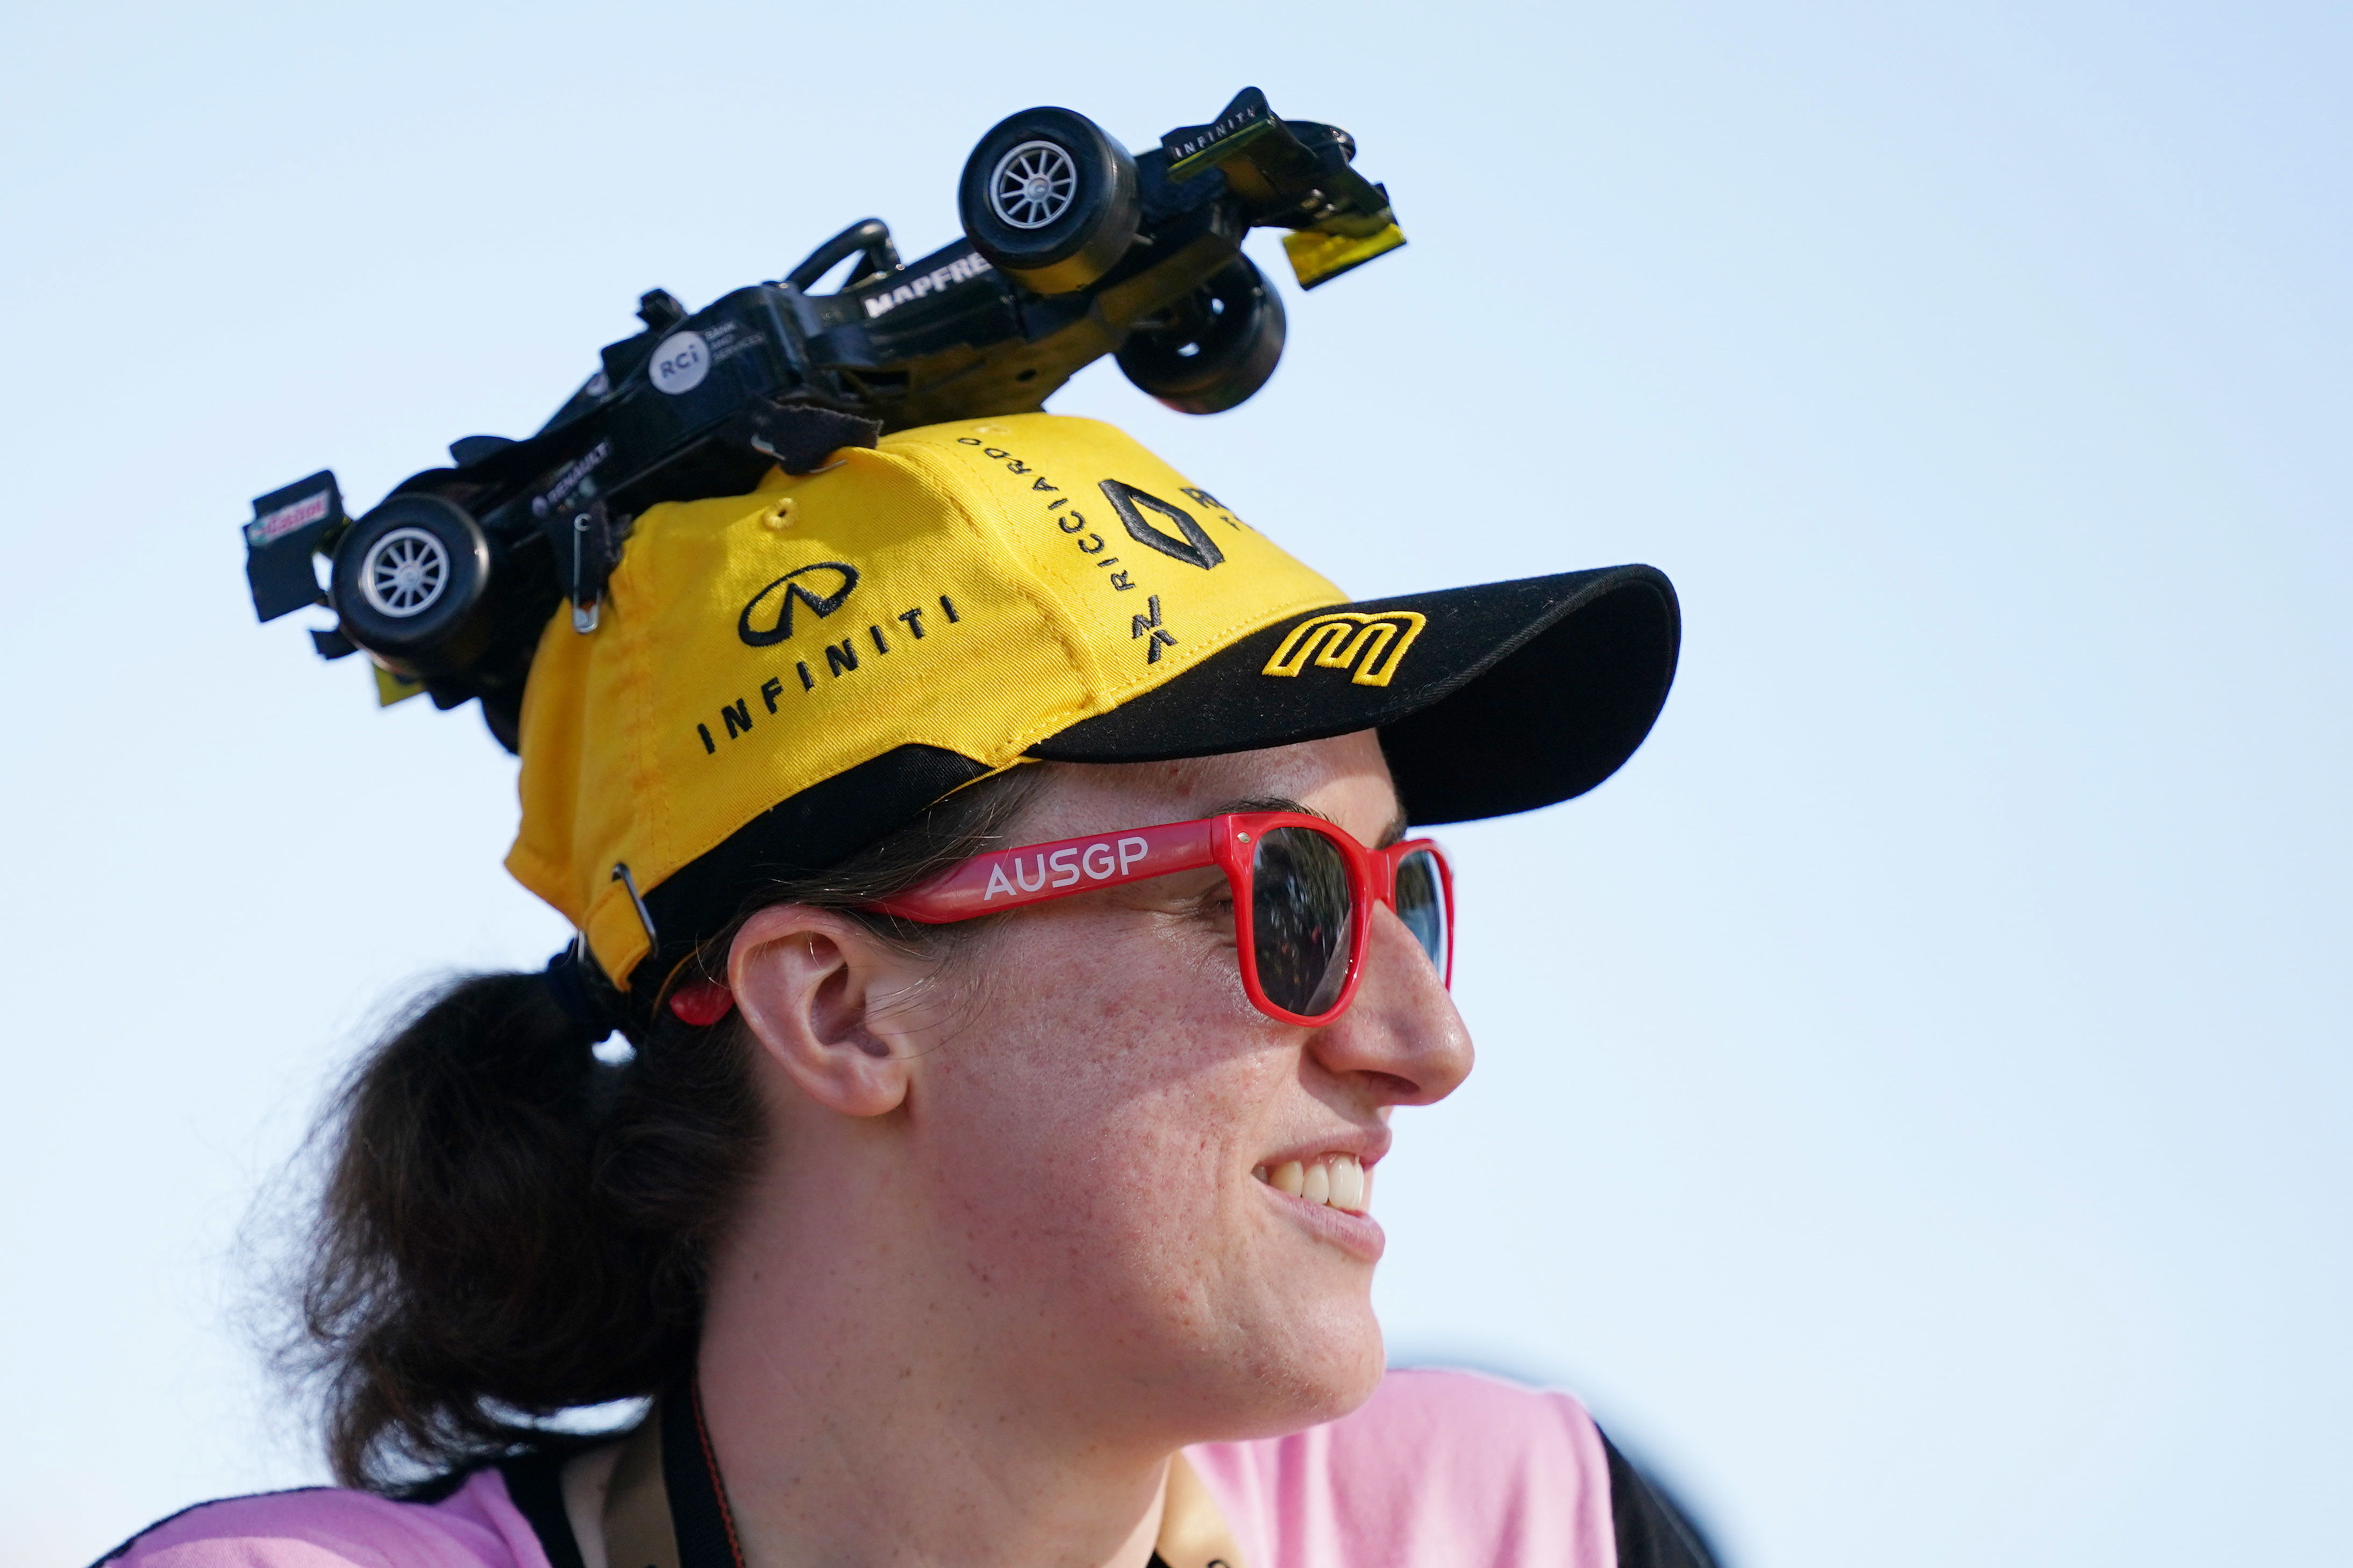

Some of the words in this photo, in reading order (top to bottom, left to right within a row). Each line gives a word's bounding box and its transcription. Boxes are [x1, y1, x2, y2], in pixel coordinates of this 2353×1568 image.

[865, 250, 994, 318] MAPFRE
[957, 438, 1136, 592] RICCIARDO
[697, 595, 960, 754] INFINITI
[983, 836, 1149, 901] AUSGP
